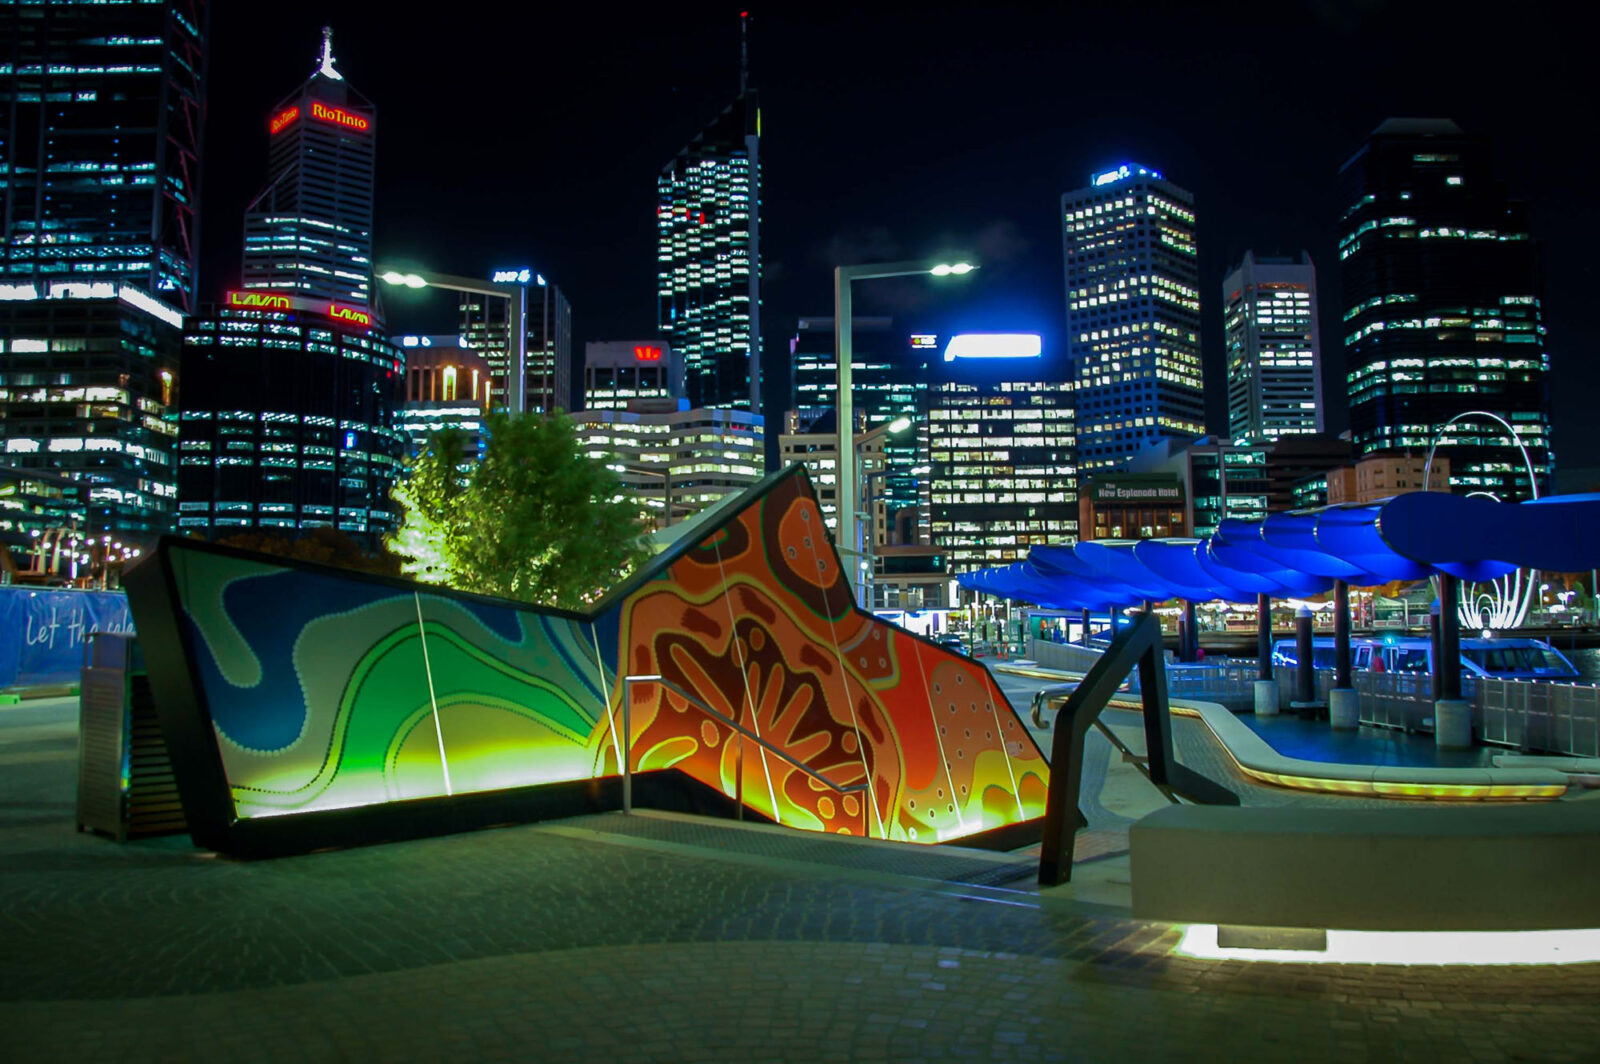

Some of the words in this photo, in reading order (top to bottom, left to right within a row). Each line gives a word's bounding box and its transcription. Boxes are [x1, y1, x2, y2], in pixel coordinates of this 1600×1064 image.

[1098, 489, 1116, 498] New
[1117, 488, 1157, 499] Esplanade
[1158, 488, 1179, 497] Hotel
[27, 607, 60, 649] Let
